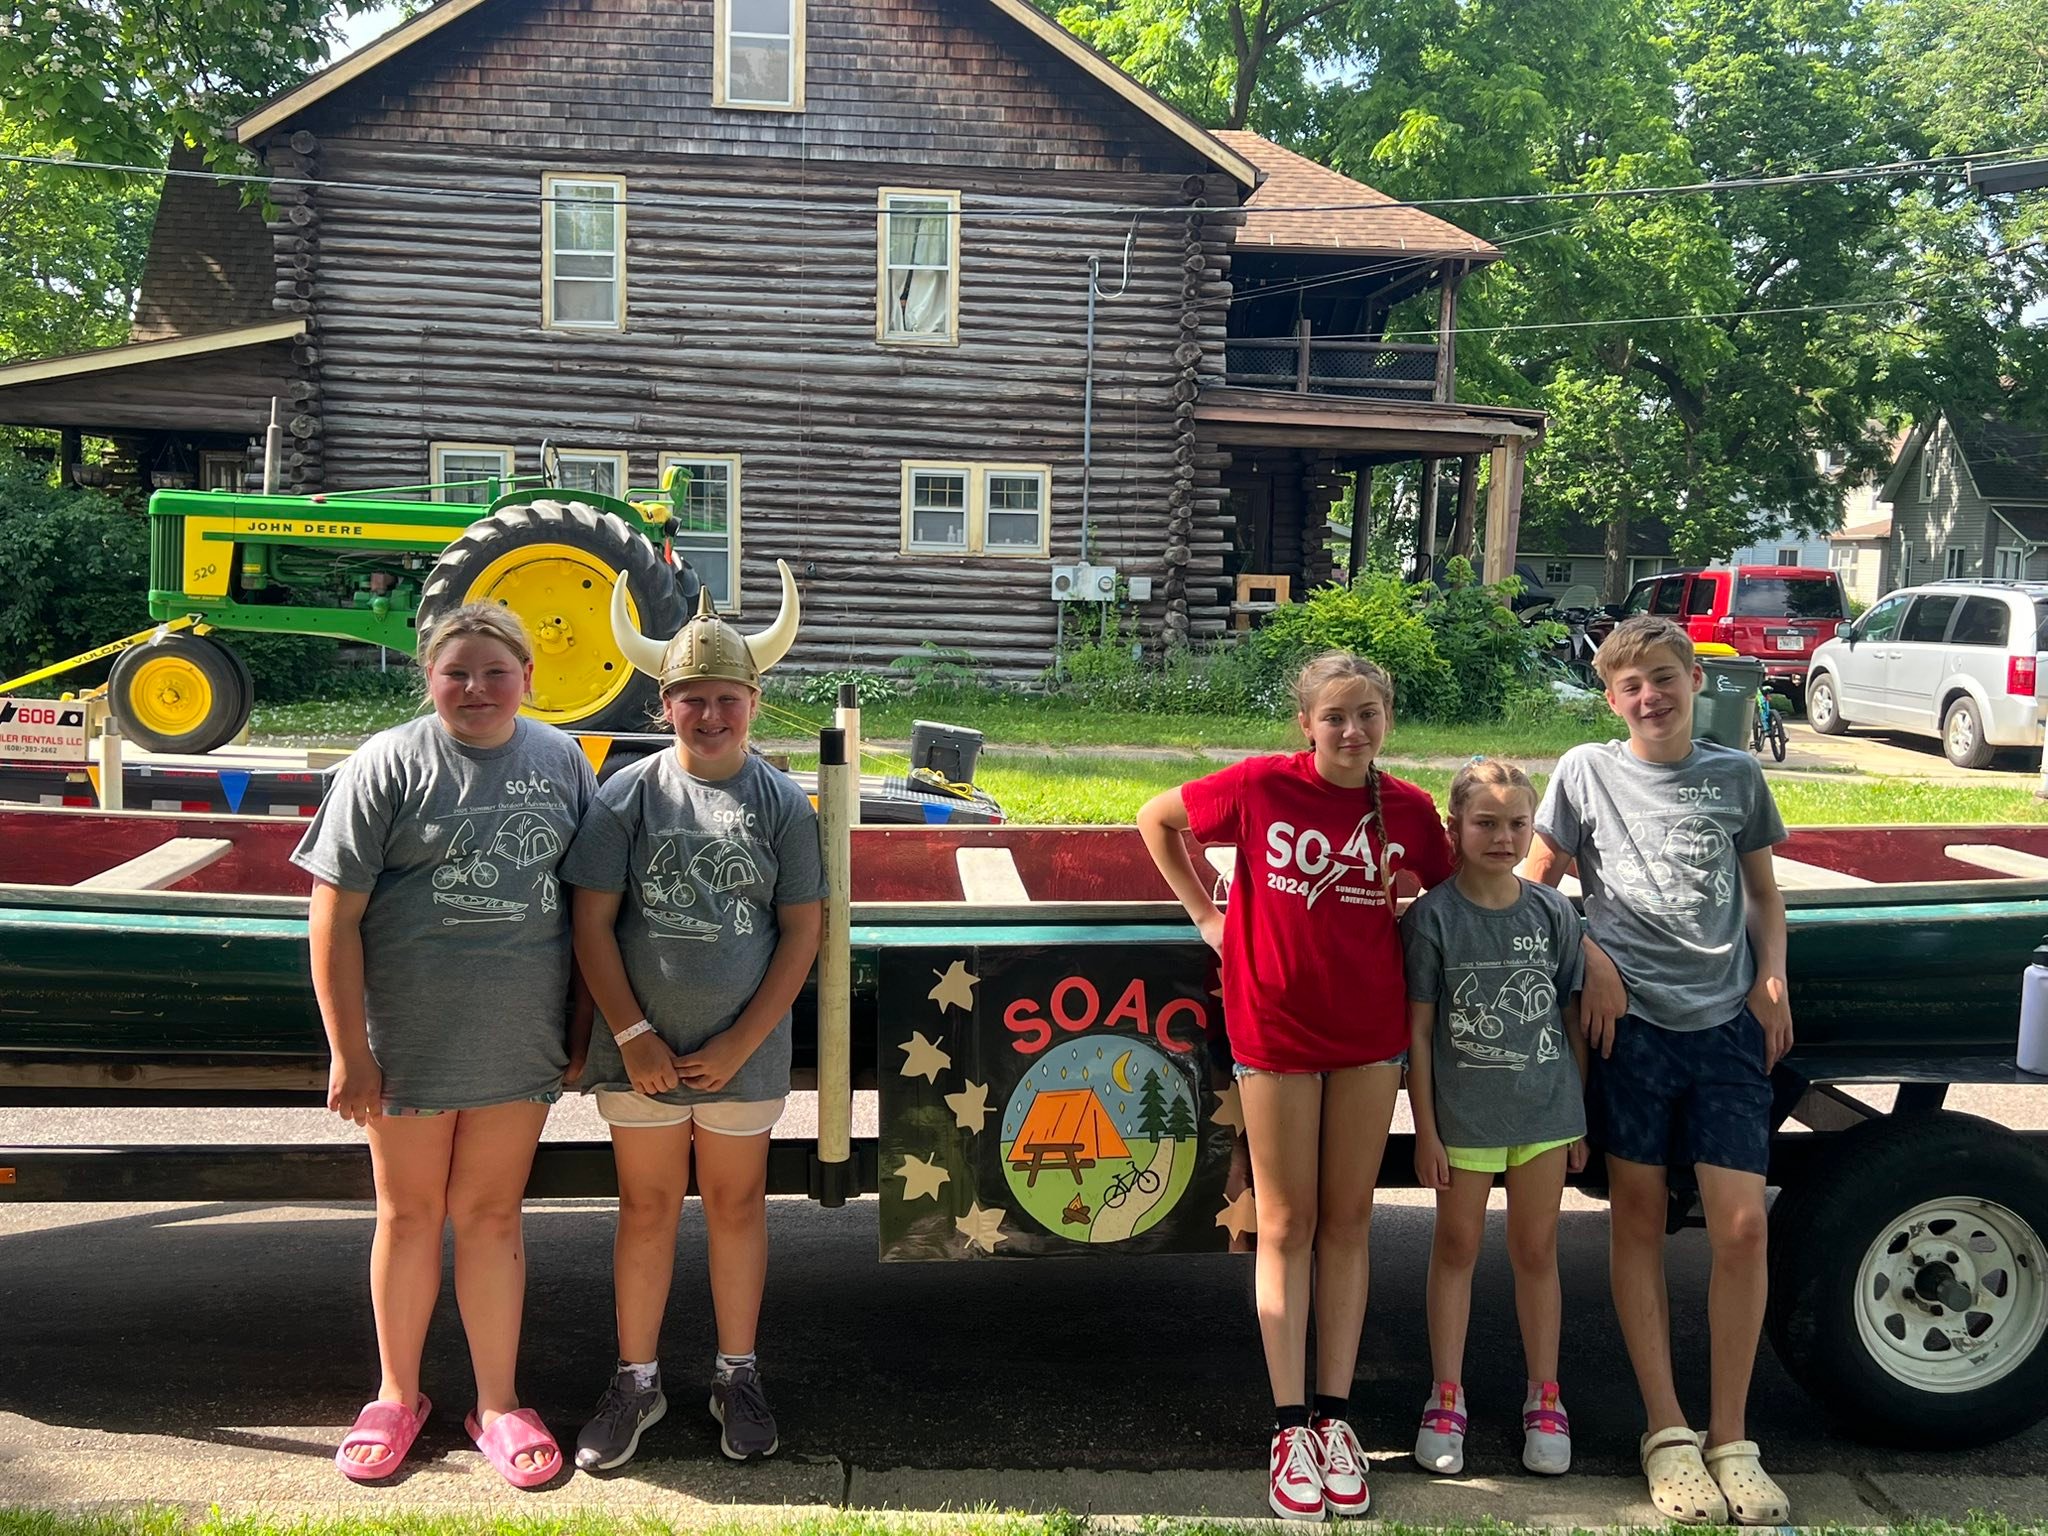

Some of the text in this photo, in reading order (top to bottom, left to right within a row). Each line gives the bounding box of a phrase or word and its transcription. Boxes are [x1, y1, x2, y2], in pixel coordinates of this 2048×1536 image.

[248, 522, 362, 535] JOHN DEERE
[193, 563, 217, 582] 520
[72, 637, 136, 666] VULCAN
[18, 708, 56, 725] 608
[21, 735, 64, 745] RENTALS
[66, 737, 82, 746] LLC
[505, 773, 550, 800] SOAC
[1678, 780, 1721, 803] SOAC
[1267, 873, 1310, 896] 2024
[1335, 885, 1365, 895] SUMMER
[1003, 976, 1206, 1054] SOAC
